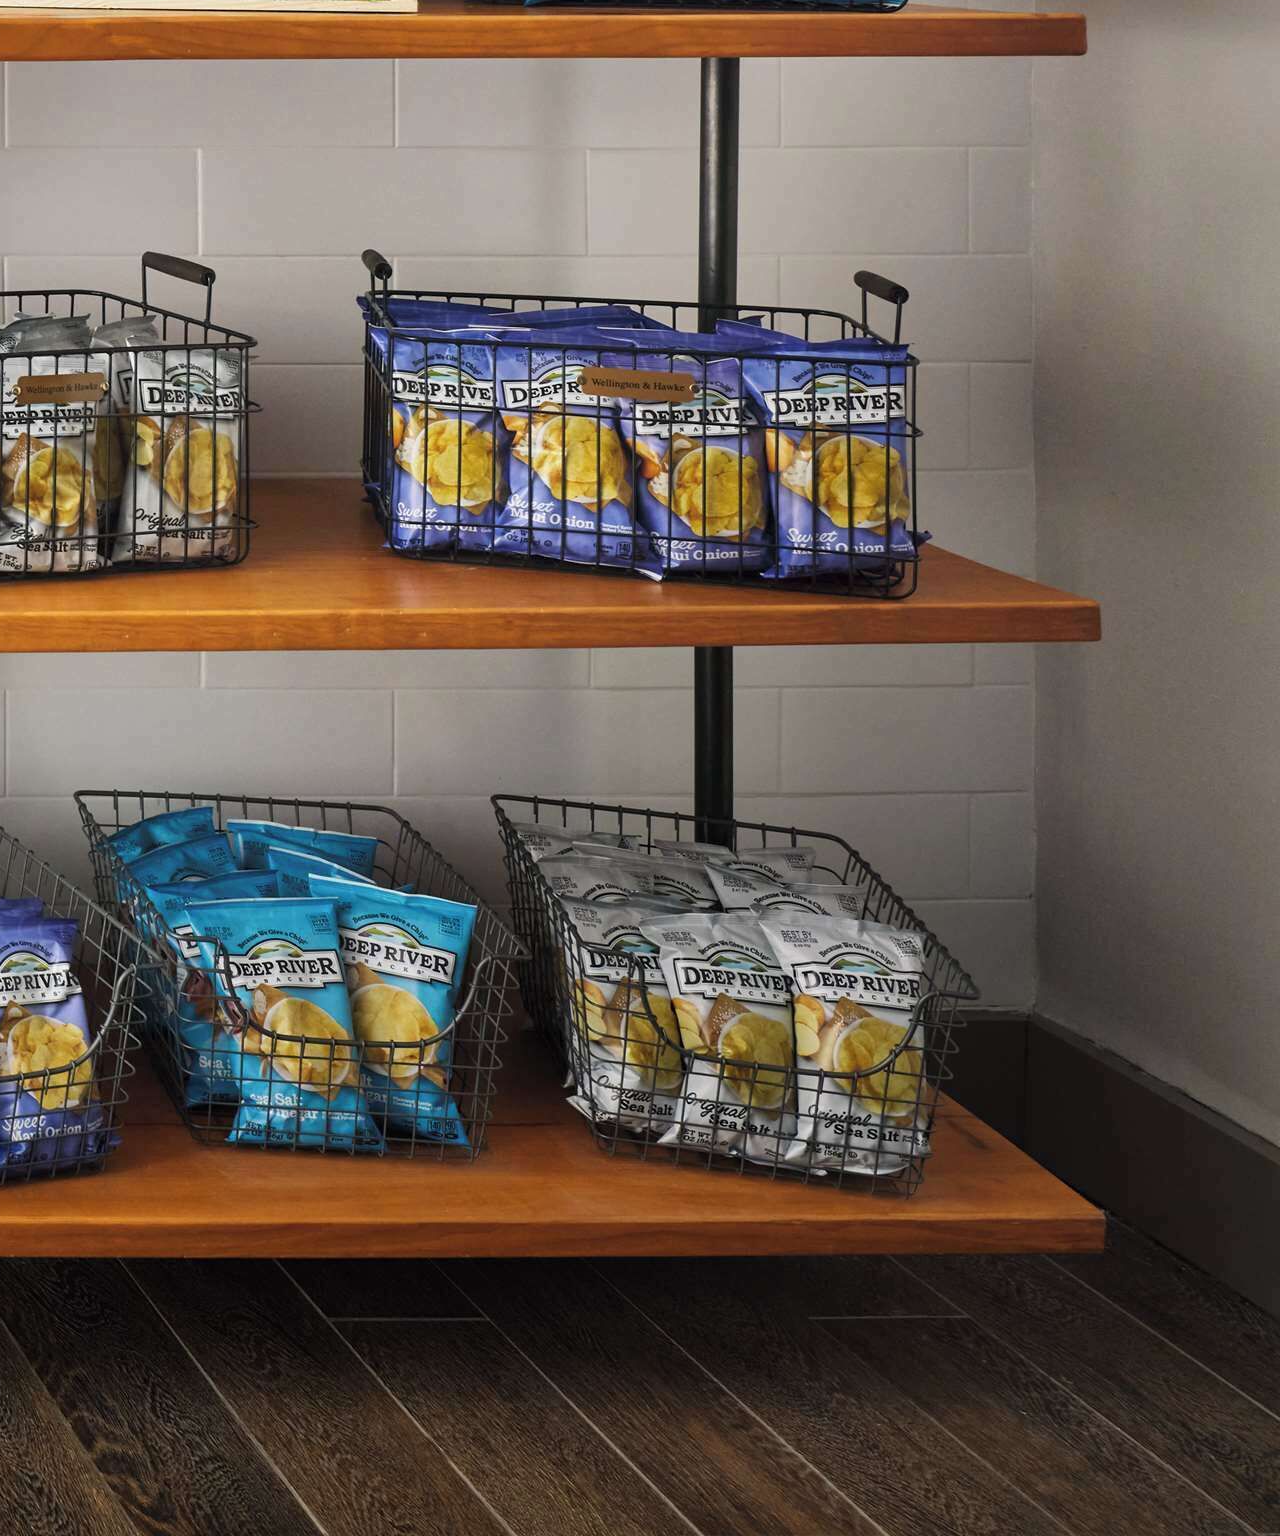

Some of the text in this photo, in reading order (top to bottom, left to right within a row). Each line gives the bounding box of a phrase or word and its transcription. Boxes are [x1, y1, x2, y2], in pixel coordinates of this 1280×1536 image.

[25, 384, 65, 395] Wellington
[66, 383, 73, 392] &
[392, 377, 442, 397] DEEP
[509, 383, 563, 404] DEEP
[591, 377, 686, 393] Wellington & Hawke
[771, 391, 904, 416] DEEP RIVER
[640, 408, 695, 427] DEEP
[134, 508, 187, 530] Original
[549, 514, 595, 531] Onion
[786, 527, 839, 543] Sweet
[693, 547, 740, 562] Onion
[753, 891, 781, 903] Because
[353, 913, 379, 924] Because
[378, 911, 391, 920] We
[390, 913, 407, 925] Give
[268, 929, 284, 938] Give
[818, 941, 843, 959] Because
[842, 941, 854, 951] We
[853, 942, 870, 953] Give
[279, 957, 338, 976] RIVER
[384, 946, 449, 976] RIVER
[22, 968, 81, 991] RIVER
[682, 966, 736, 986] DEEP
[801, 969, 921, 999] DEEP RIVER
[619, 1098, 674, 1117] Sea Salt
[685, 1092, 748, 1120] Original
[708, 1113, 738, 1131] Sea
[807, 1104, 873, 1129] Original
[833, 1124, 900, 1143] Sea Salt
